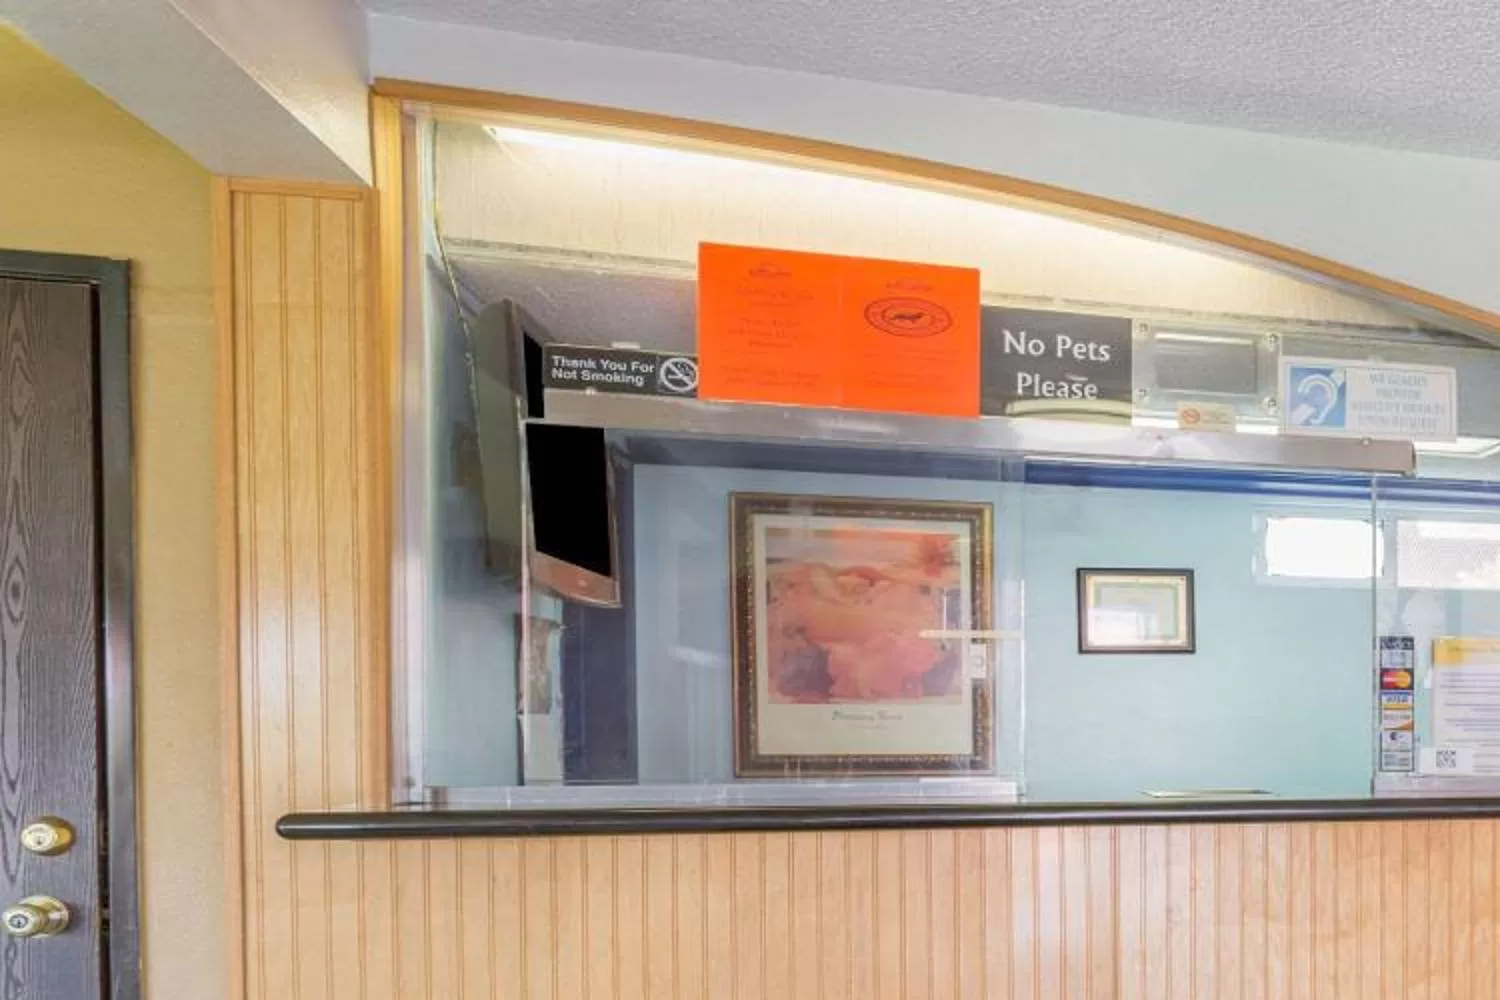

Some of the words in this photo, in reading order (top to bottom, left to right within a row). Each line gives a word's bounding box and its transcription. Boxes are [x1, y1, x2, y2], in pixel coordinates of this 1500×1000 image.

[1002, 329, 1046, 357] No
[1056, 333, 1111, 361] Pets
[551, 355, 597, 370] Thank
[600, 359, 627, 372] You
[631, 361, 655, 373] For
[551, 367, 577, 379] Not
[581, 370, 644, 387] Smoking
[1017, 371, 1098, 400] Please
